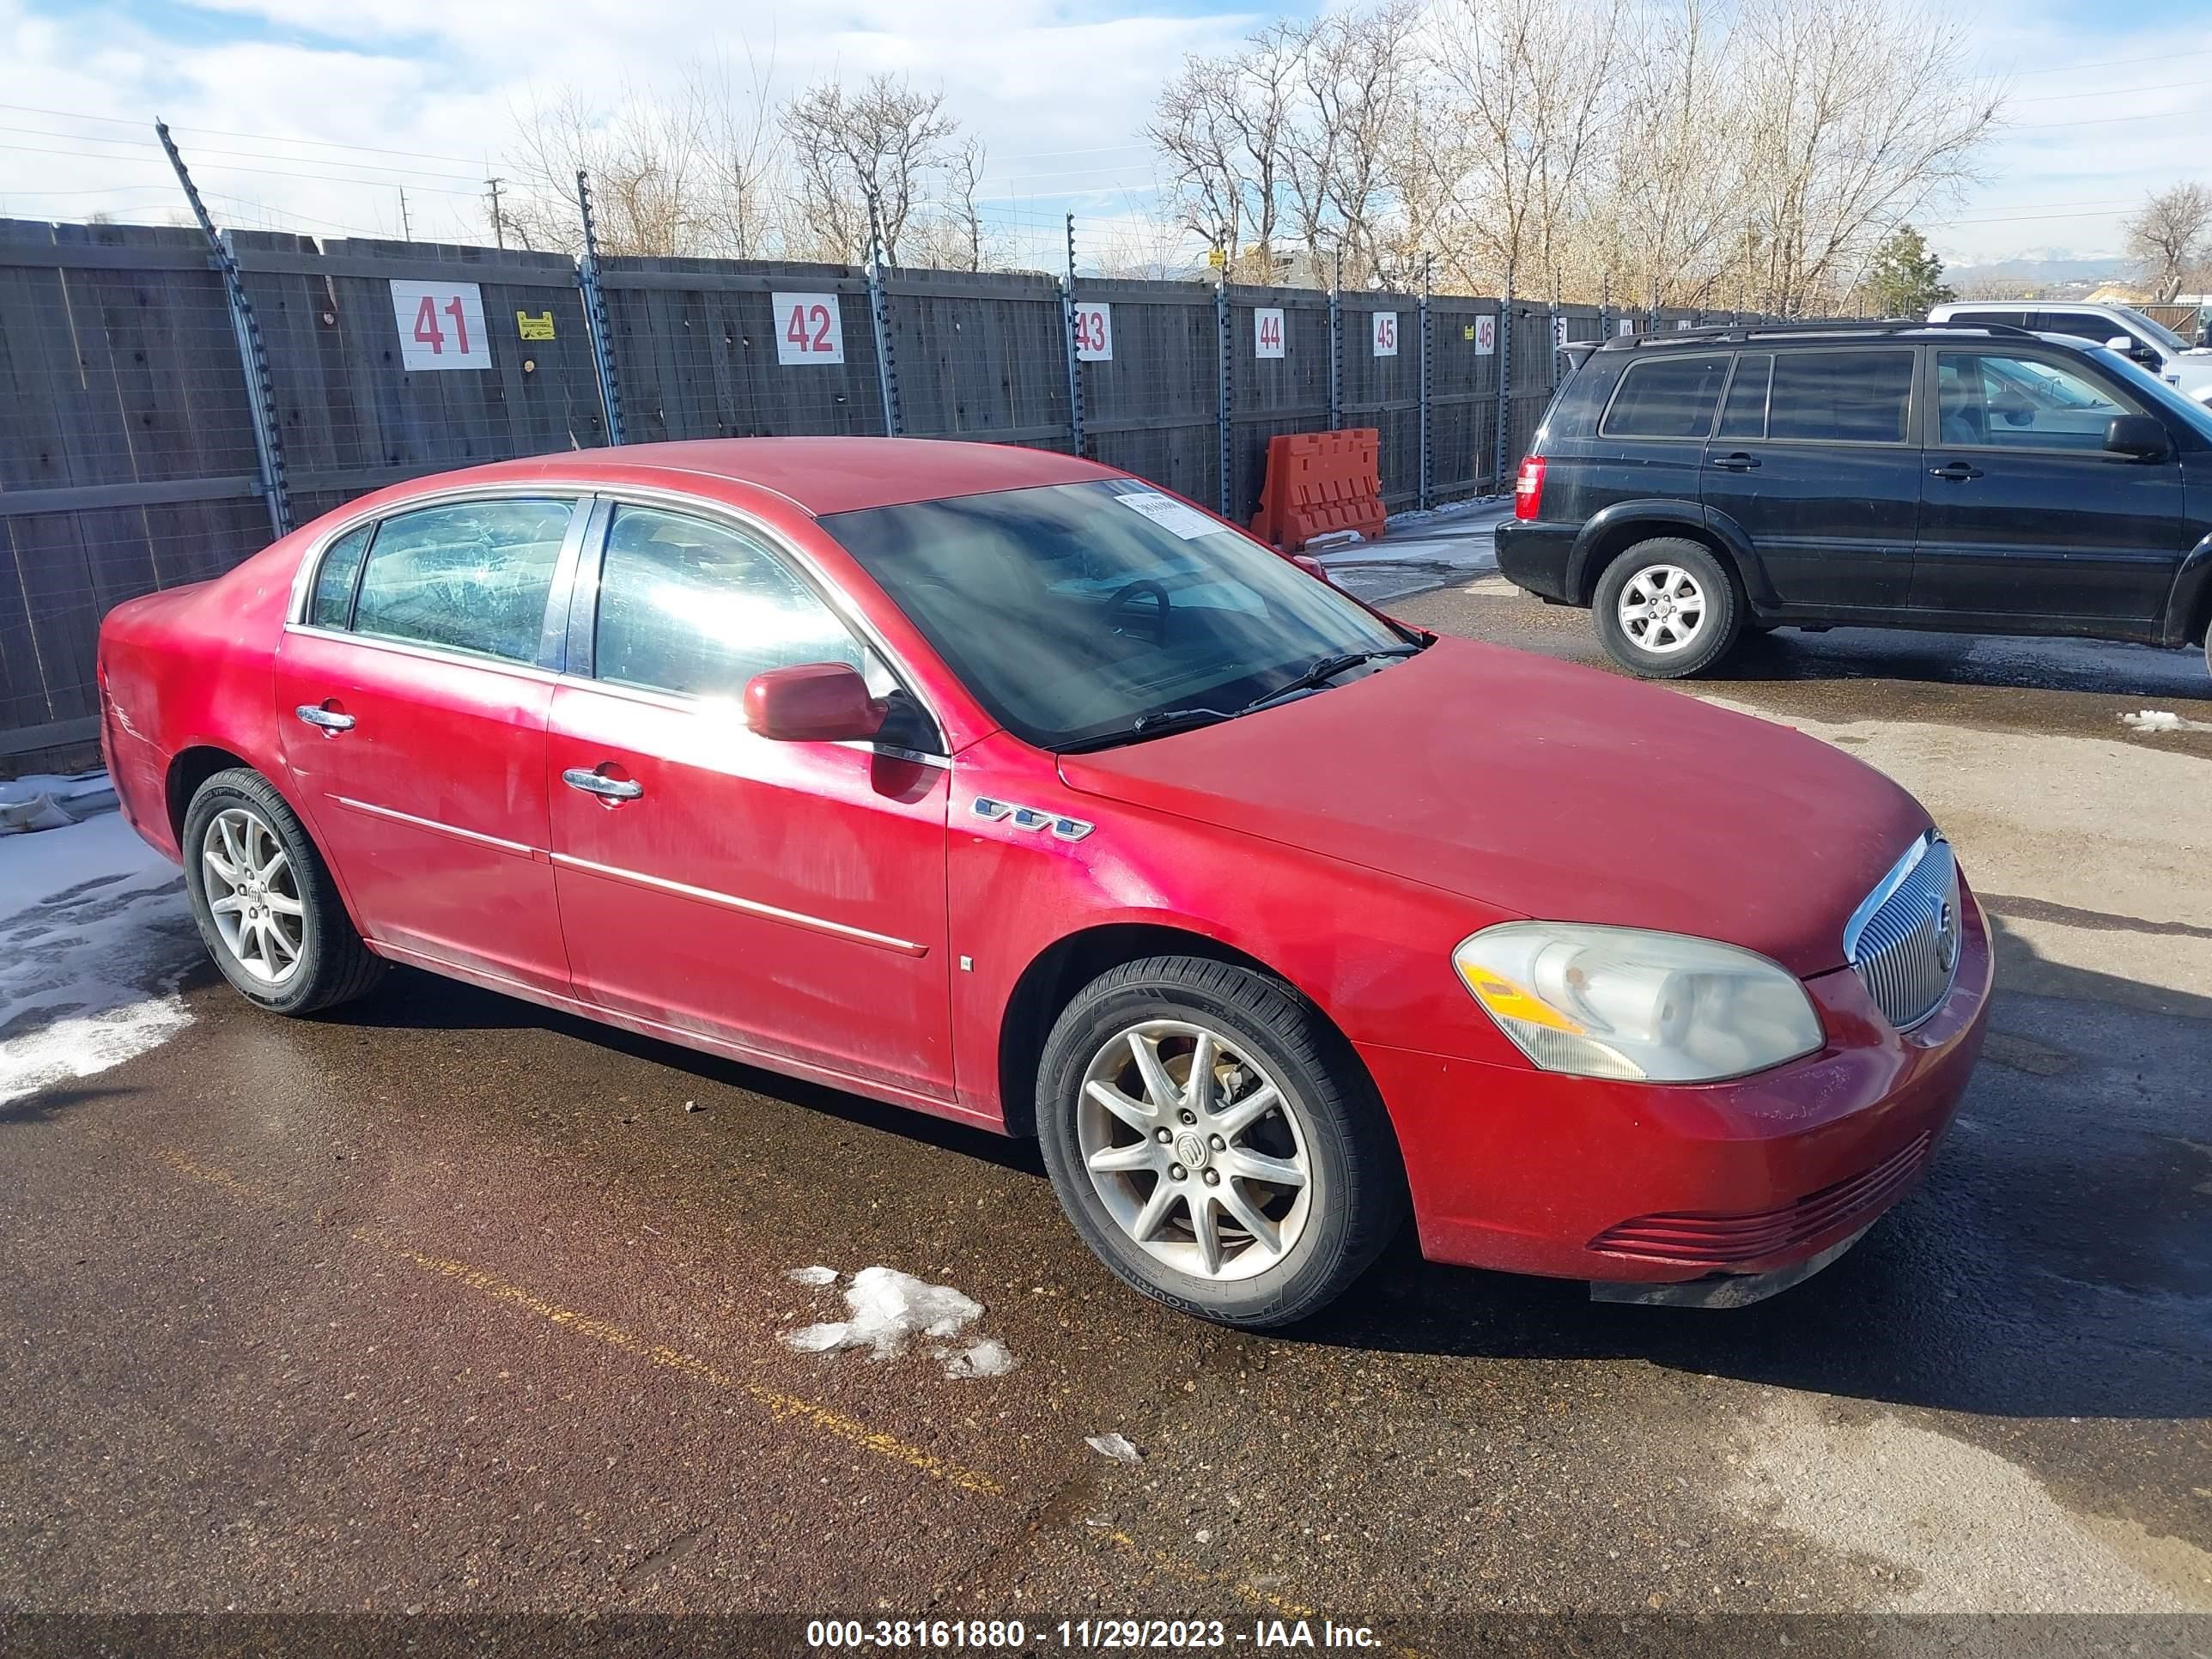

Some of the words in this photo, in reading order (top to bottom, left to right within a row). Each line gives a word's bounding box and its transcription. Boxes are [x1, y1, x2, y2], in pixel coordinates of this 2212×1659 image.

[414, 296, 470, 354] 41
[787, 305, 833, 352] 42
[1076, 312, 1105, 351] 43
[1261, 317, 1280, 349] 44
[1377, 319, 1394, 349] 45
[1479, 322, 1492, 349] 46
[1111, 1258, 1194, 1310] TOURING
